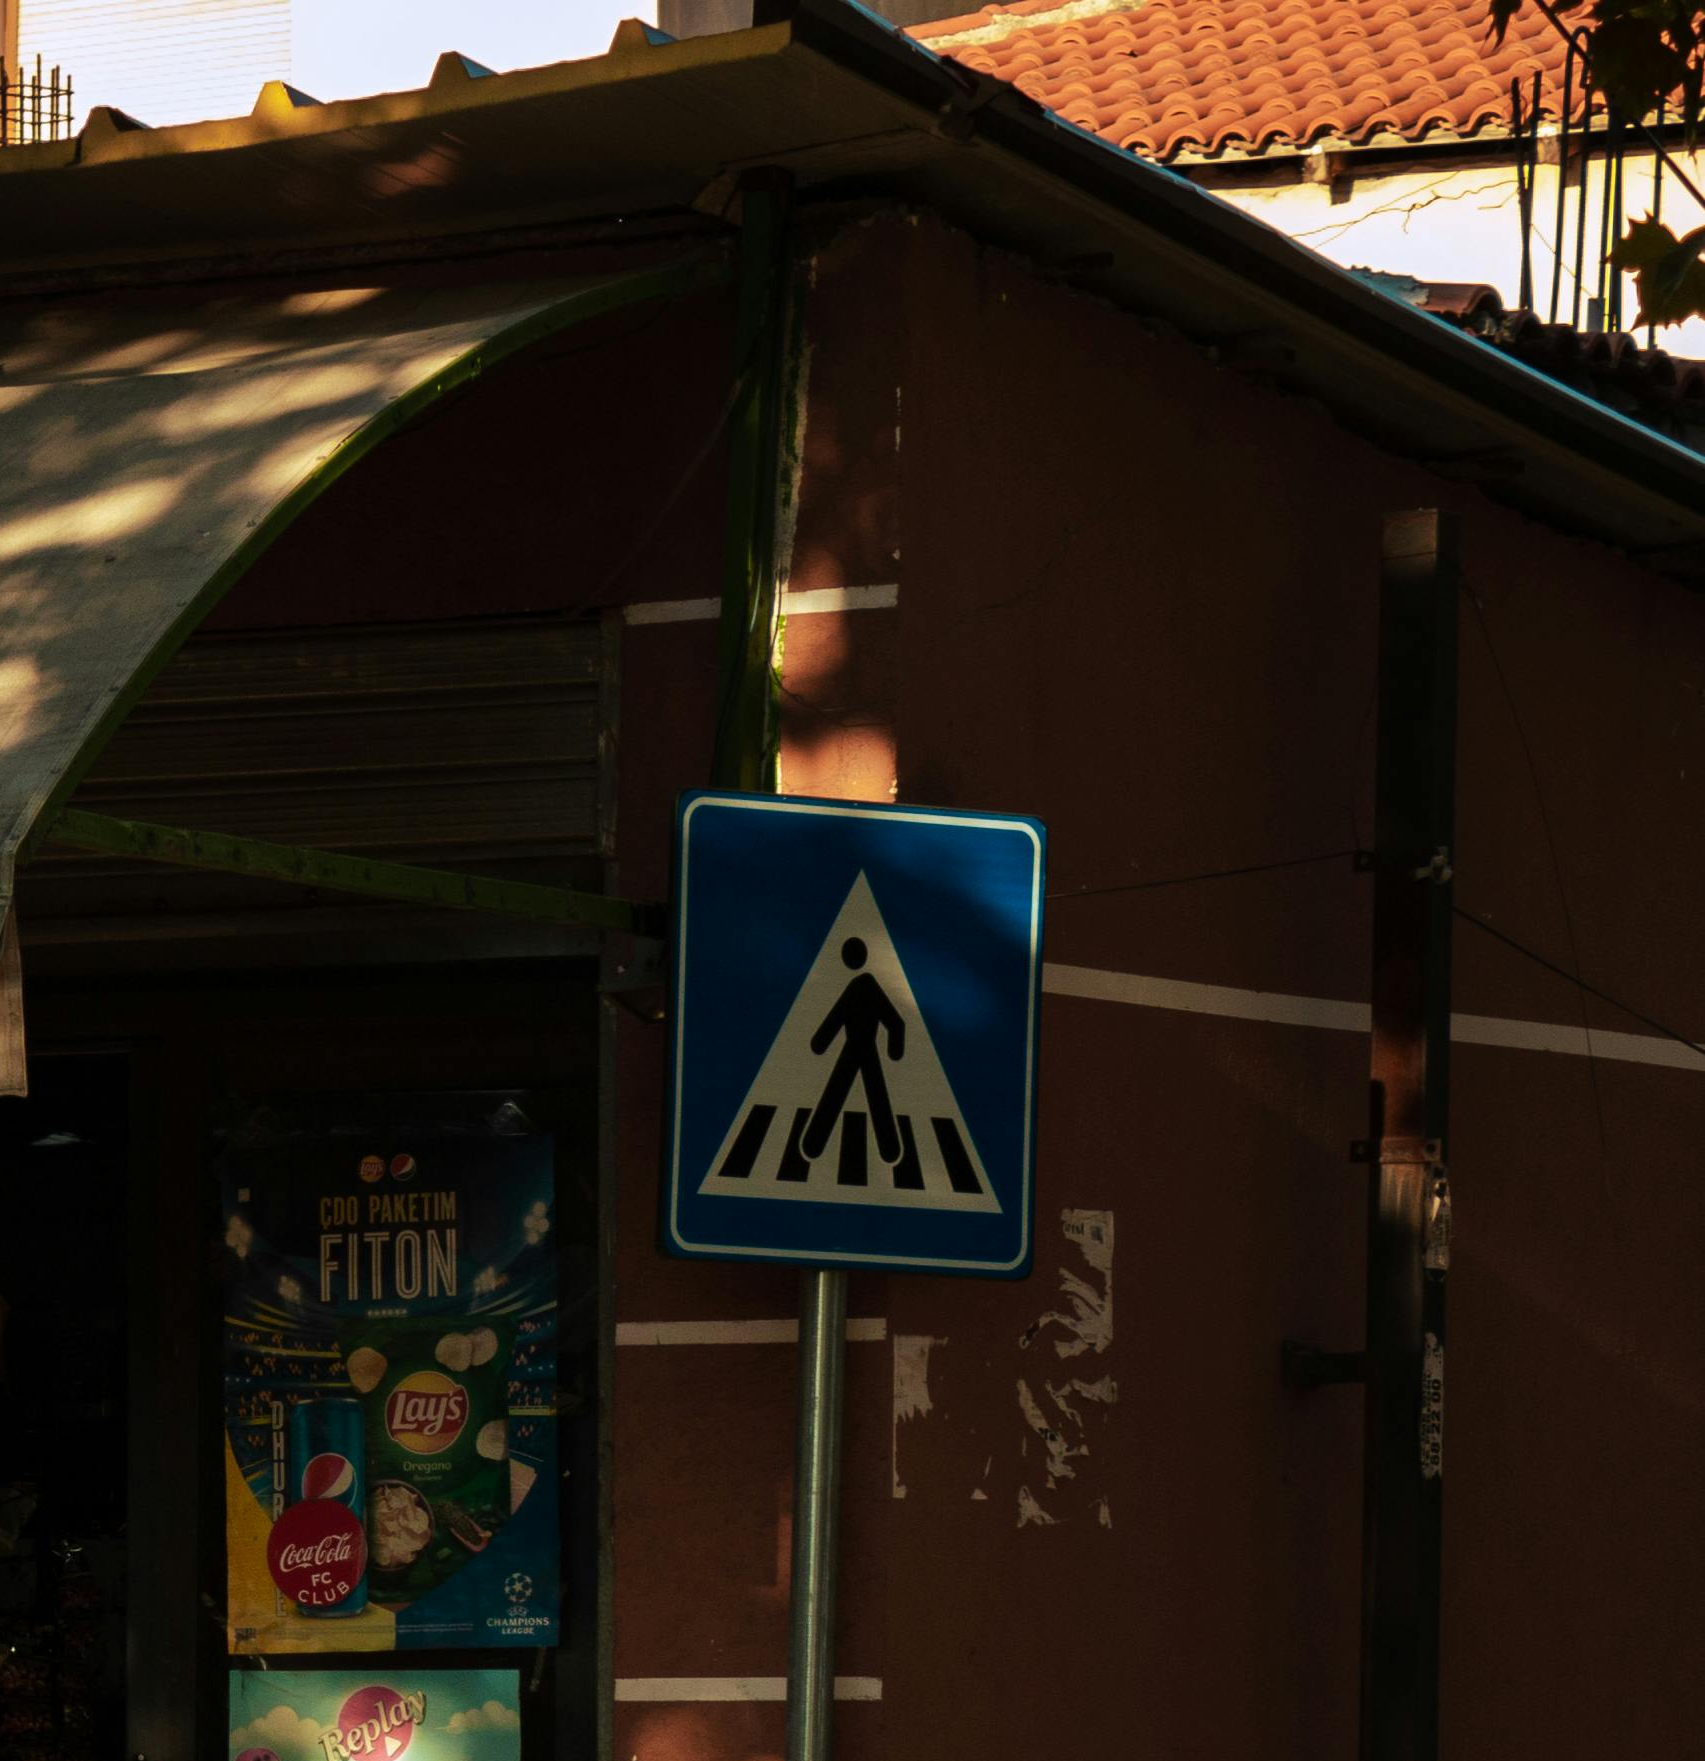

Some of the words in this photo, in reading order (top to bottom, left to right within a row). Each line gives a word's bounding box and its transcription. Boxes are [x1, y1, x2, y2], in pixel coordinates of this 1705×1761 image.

[319, 1195, 359, 1230] ÇDO
[369, 1190, 457, 1224] PAKETIM
[319, 1228, 458, 1303] FITON
[391, 1391, 463, 1435] Lay's
[311, 1572, 332, 1587] FC
[298, 1581, 350, 1604] CLUB
[486, 1616, 550, 1628] CHAMPIONS
[501, 1627, 535, 1636] LEAGUE
